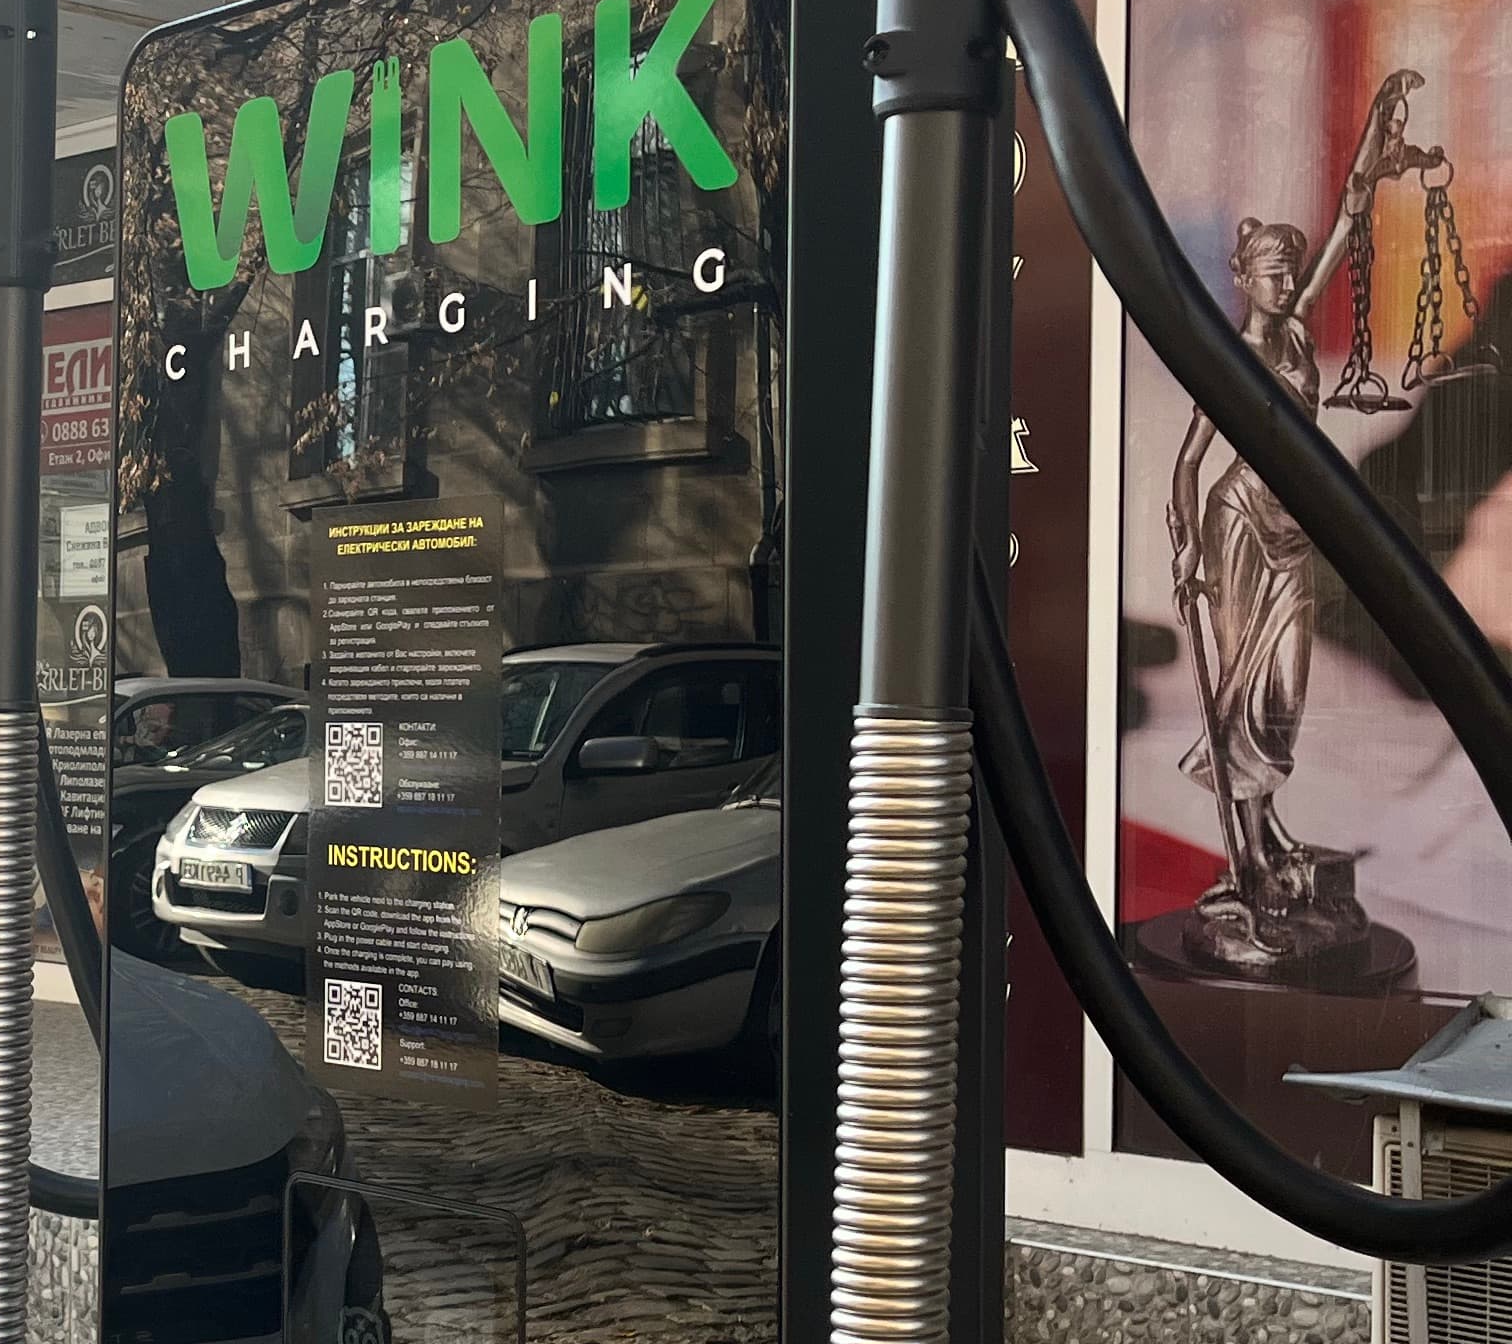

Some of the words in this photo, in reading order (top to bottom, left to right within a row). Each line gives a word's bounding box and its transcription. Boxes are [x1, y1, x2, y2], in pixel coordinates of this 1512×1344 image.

[165, 248, 726, 381] CHARGING
[52, 419, 88, 442] 0888
[92, 417, 110, 437] 63
[48, 451, 74, 467] Етаж
[76, 450, 86, 465] 2,
[328, 523, 390, 539] ИНСТРУКЦИИ
[391, 522, 405, 534] ЗА
[405, 517, 467, 533] ЗАРЕЖДАНЕ
[468, 516, 484, 528] НА
[337, 540, 411, 555] ЕЛЕКТРИЧЕСКИ
[412, 536, 478, 551] АВТОМОБИЛ:
[54, 726, 91, 744] Лазерна
[90, 824, 102, 836] на
[327, 843, 478, 875] INSTRUCTIONS:
[324, 891, 338, 901] Park
[339, 893, 349, 902] the
[394, 897, 404, 906] the
[404, 899, 432, 910] charging
[324, 905, 339, 915] Scan
[340, 906, 350, 915] the
[351, 907, 362, 917] QR
[411, 913, 422, 922] the
[422, 914, 435, 924] app
[324, 918, 351, 930] AppStore
[352, 922, 359, 930] or
[359, 921, 395, 935] GooglePlay
[396, 925, 408, 935] and
[324, 932, 338, 943] Plug
[345, 934, 355, 943] the
[356, 936, 374, 946] power
[375, 937, 392, 947] cable
[393, 938, 405, 948] and
[324, 945, 340, 955] Once
[341, 947, 351, 957] the
[352, 949, 378, 961] charging
[415, 955, 428, 966] you
[442, 959, 454, 969] pay
[455, 959, 473, 971] using
[323, 959, 334, 968] the
[334, 961, 360, 972] methods
[360, 964, 388, 975] available
[388, 966, 395, 975] in
[395, 967, 406, 976] the
[439, 1015, 448, 1025] 11
[449, 1016, 458, 1026] 17
[439, 1061, 448, 1070] 11
[449, 1062, 458, 1072] 17
